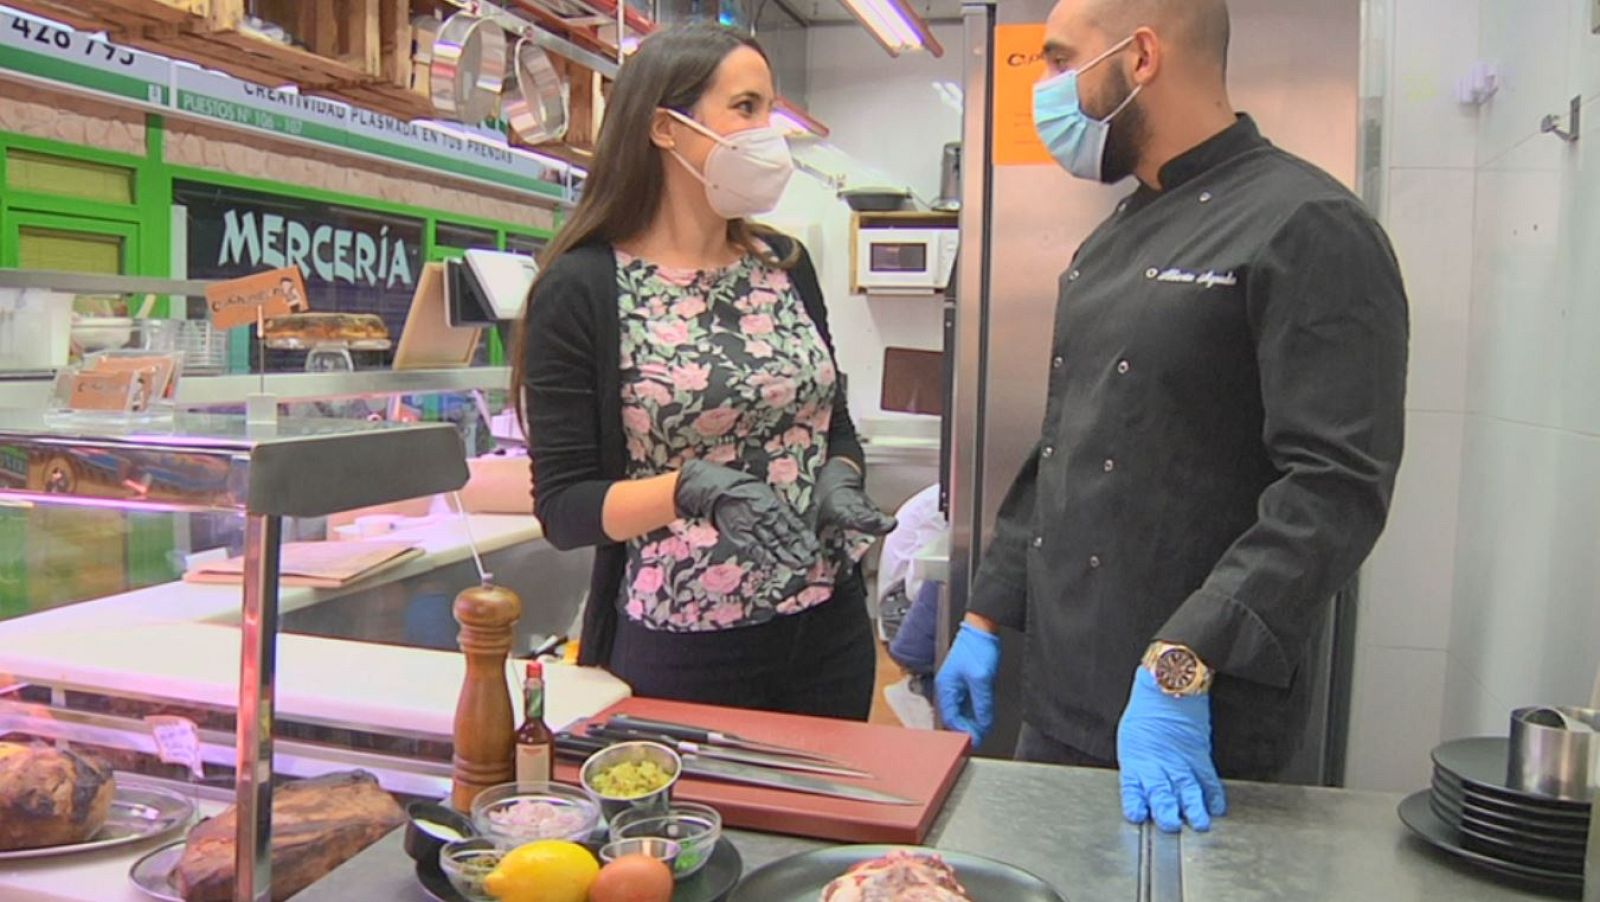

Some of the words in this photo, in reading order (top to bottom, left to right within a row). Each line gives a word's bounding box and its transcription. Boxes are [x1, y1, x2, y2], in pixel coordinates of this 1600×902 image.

[183, 94, 234, 119] PUESTOS
[350, 107, 418, 137] PLASMADA
[422, 126, 438, 144] EN
[442, 131, 463, 151] TUS
[467, 138, 513, 164] PRENDAS
[218, 209, 412, 289] MERCERÍA
